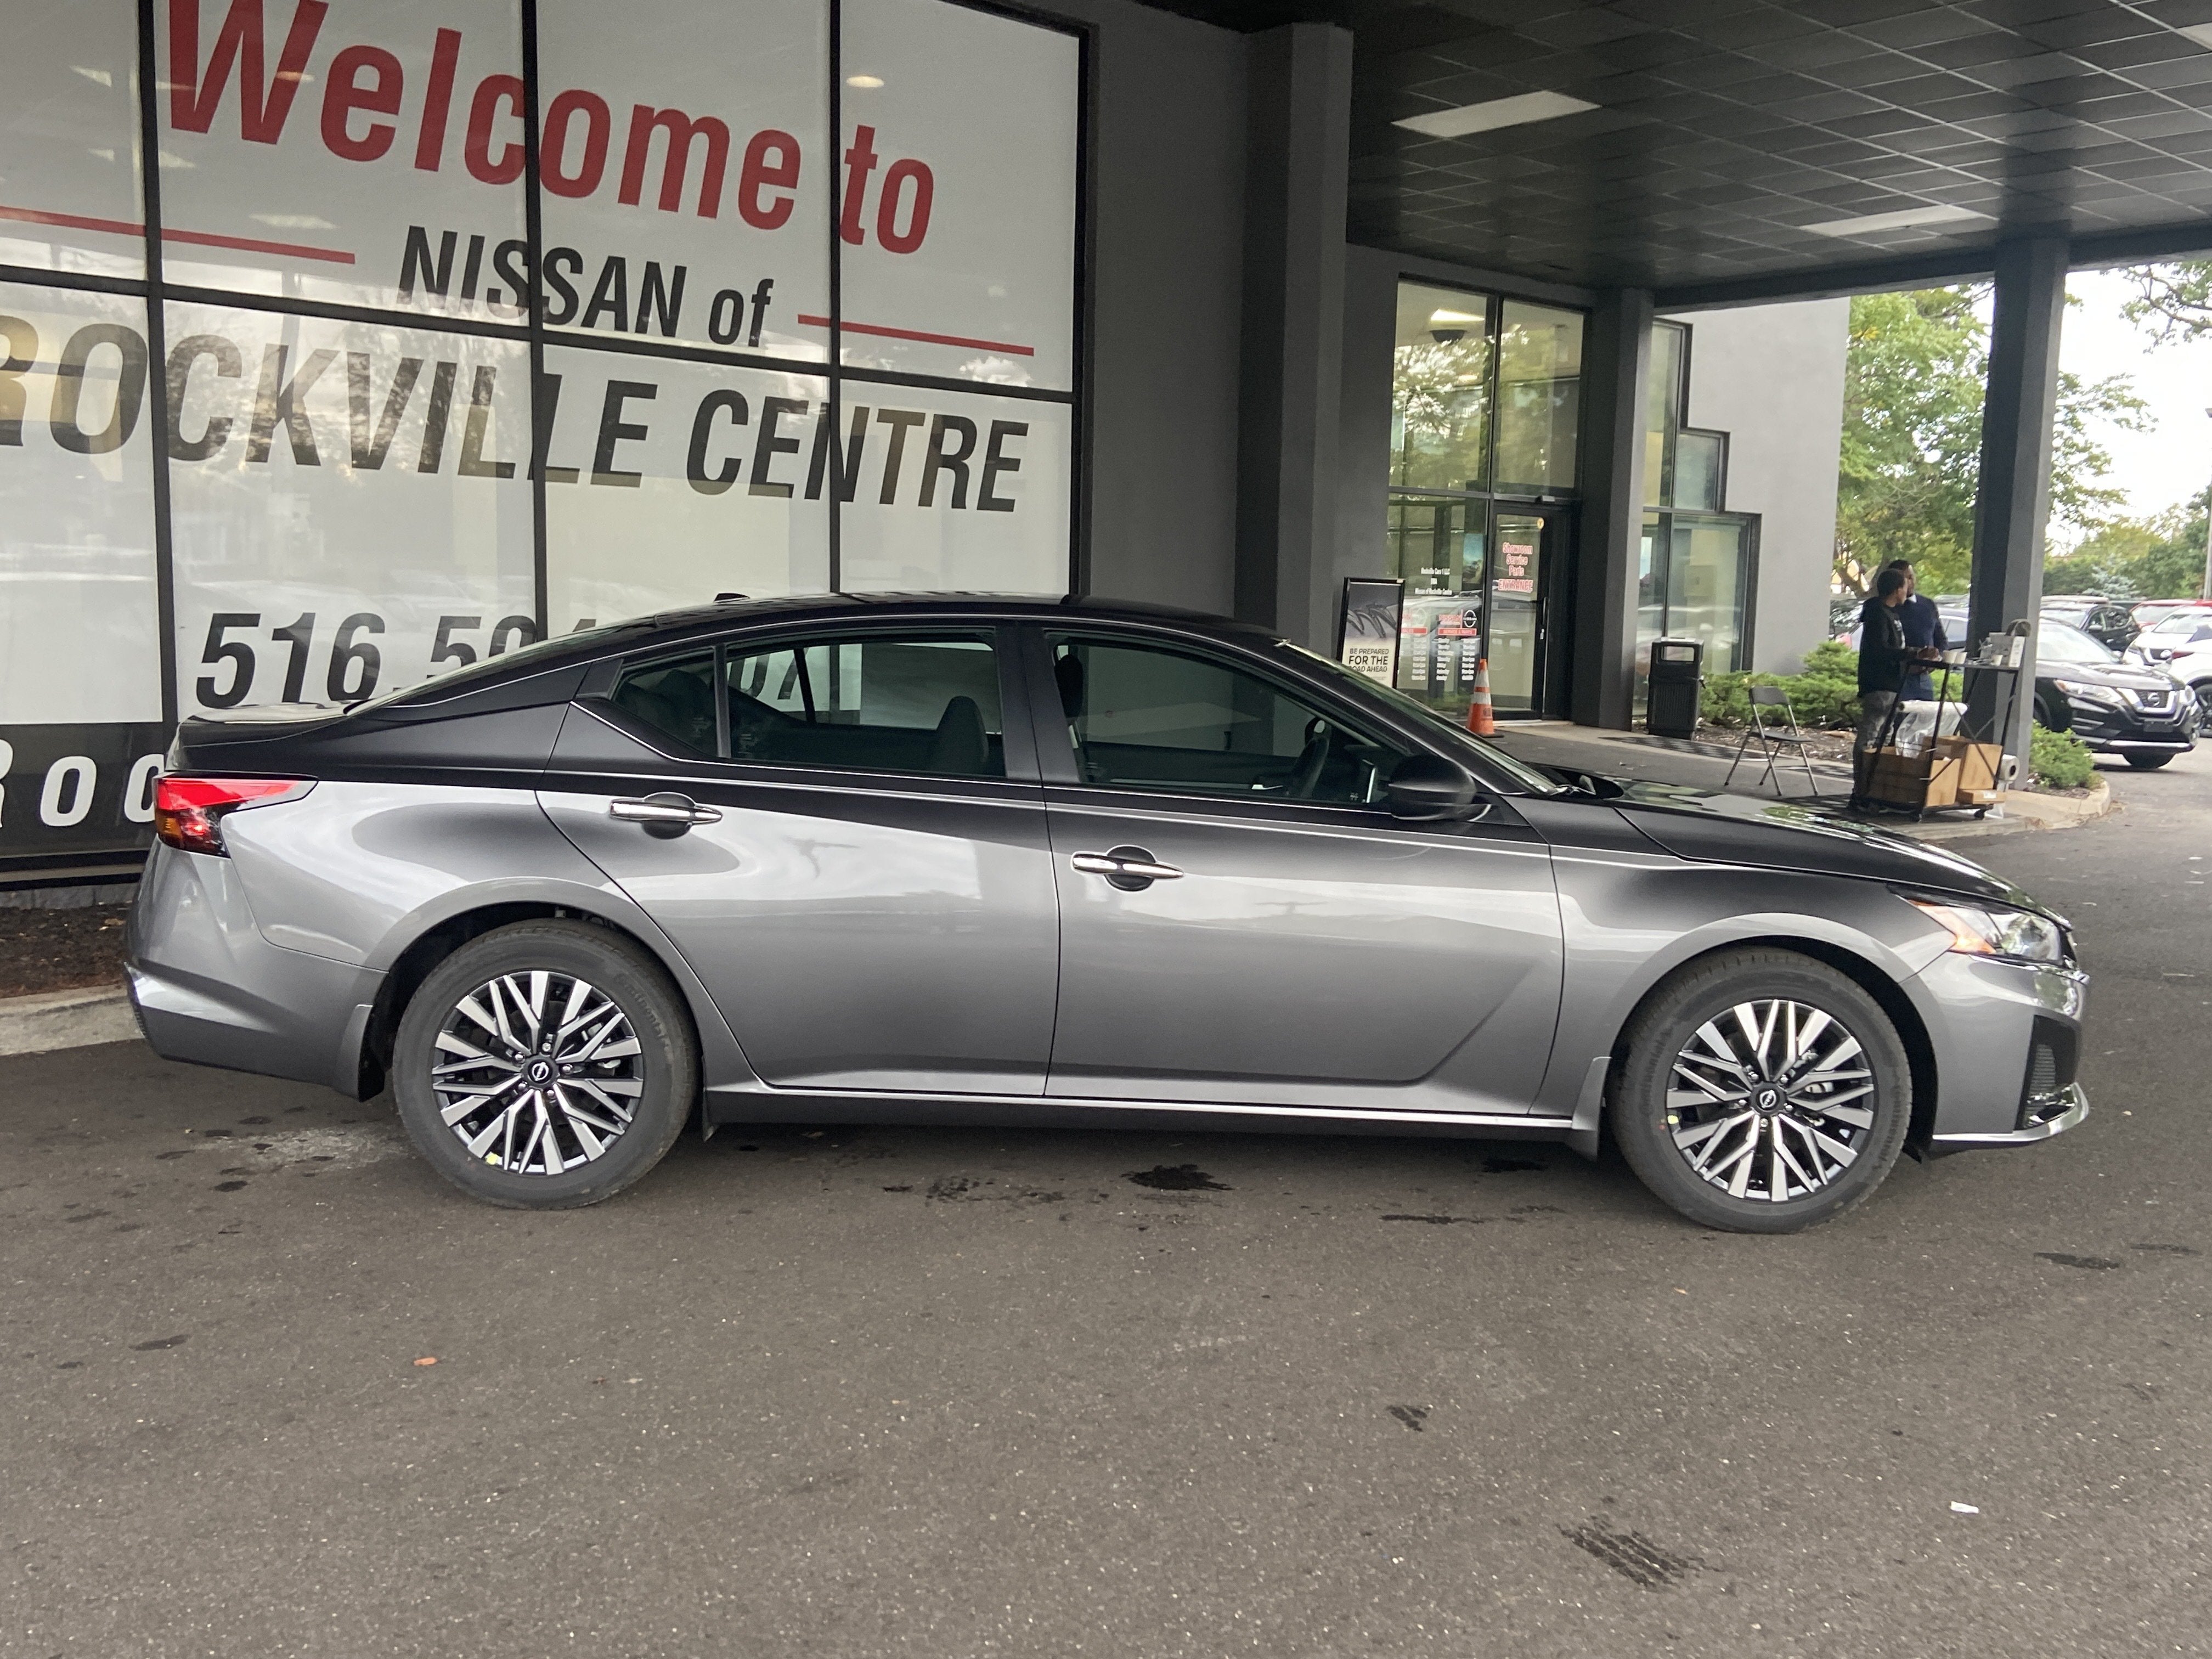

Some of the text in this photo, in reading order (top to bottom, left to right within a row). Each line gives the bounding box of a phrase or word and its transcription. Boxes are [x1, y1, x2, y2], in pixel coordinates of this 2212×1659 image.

[168, 0, 934, 254] Welcome to
[398, 225, 774, 347] NISSAN of
[686, 388, 1029, 512] CENTRE
[1503, 542, 1533, 555] Showroom
[1506, 554, 1528, 566] Service
[1509, 565, 1525, 577] Parts
[1498, 579, 1533, 593] ENTRANCE
[1348, 655, 1389, 665] FOR THE
